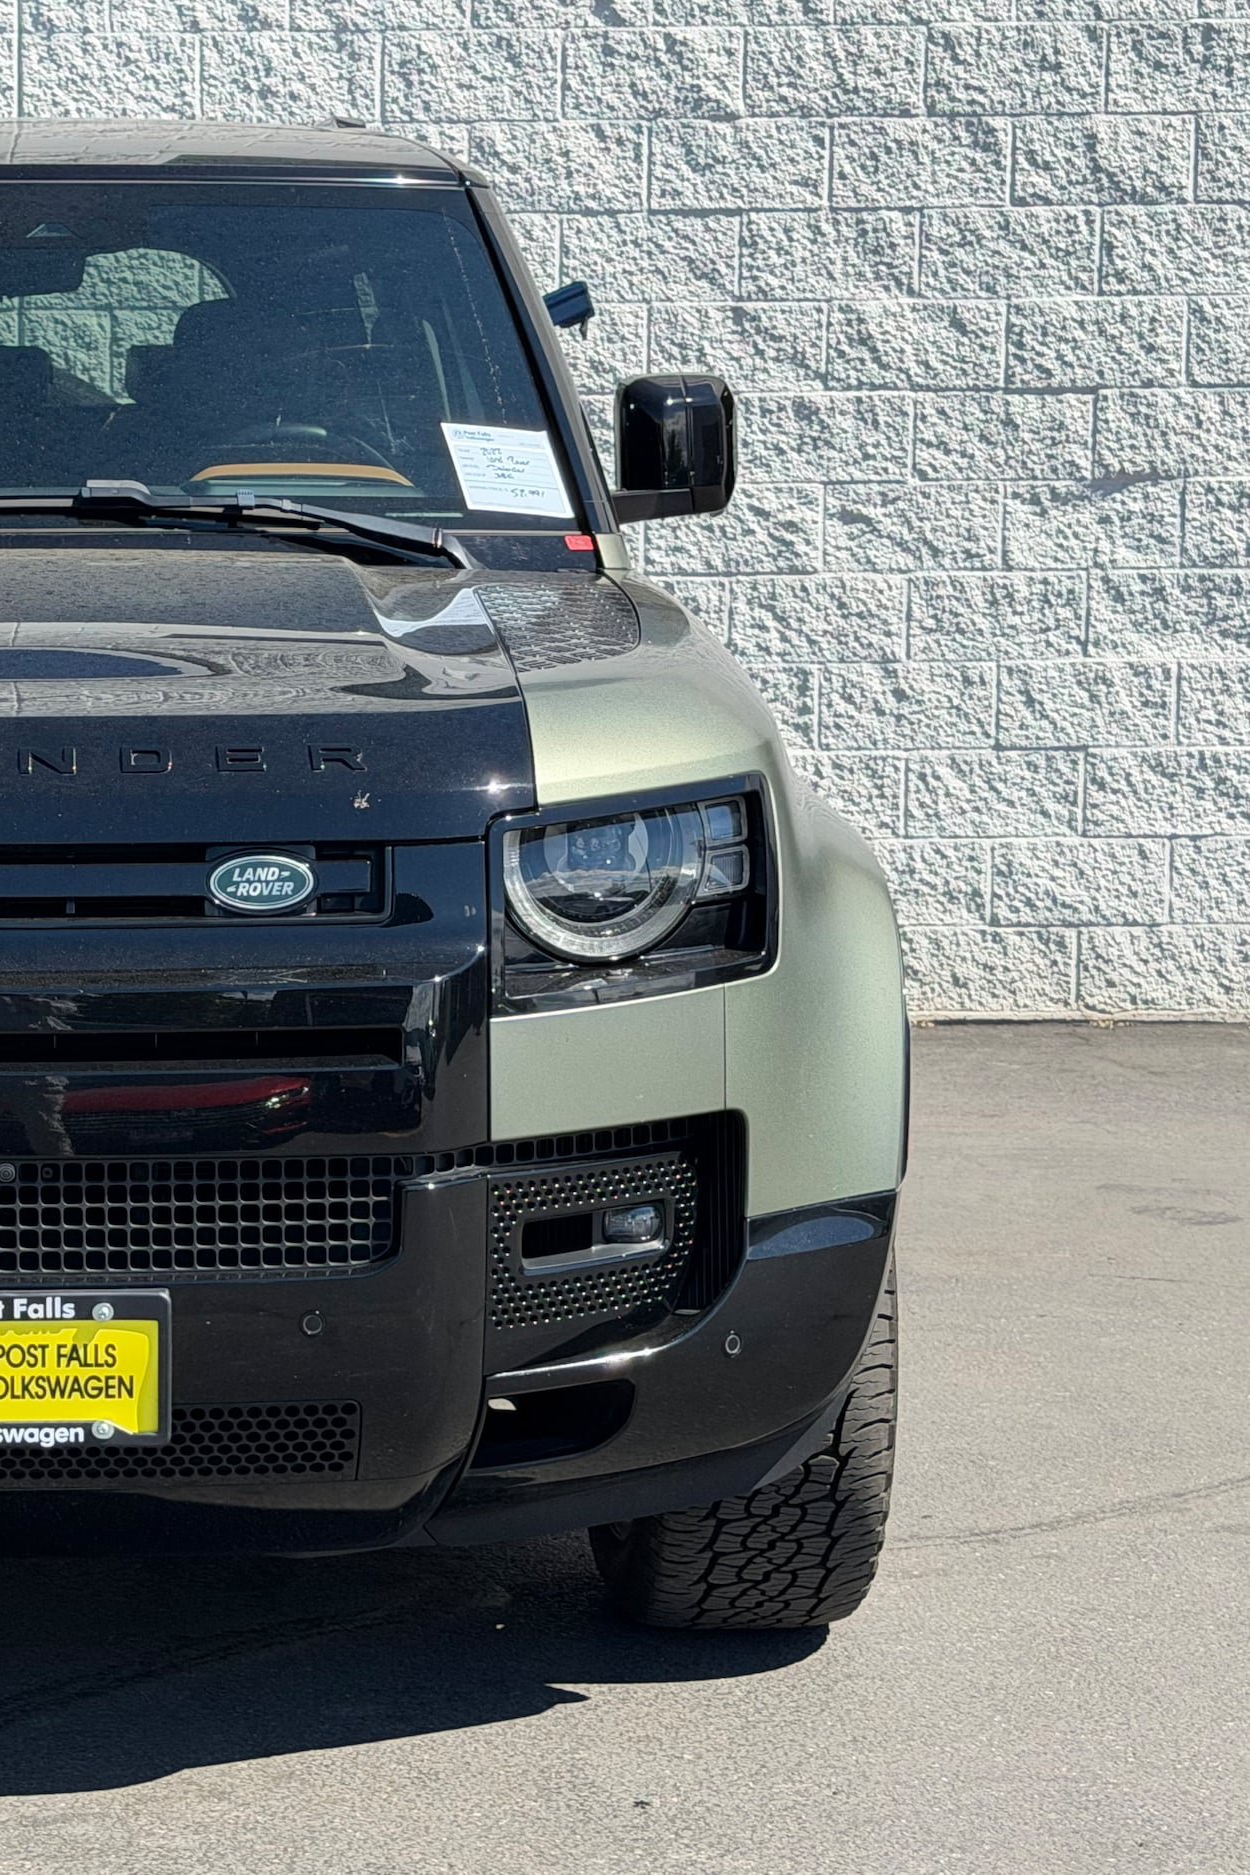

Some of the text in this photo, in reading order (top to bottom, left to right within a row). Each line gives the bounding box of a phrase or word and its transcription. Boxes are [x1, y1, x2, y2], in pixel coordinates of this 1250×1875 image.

[232, 867, 280, 881] LAND
[236, 882, 294, 896] ROVER
[13, 1297, 76, 1319] Falls
[56, 1343, 117, 1368] FALLS
